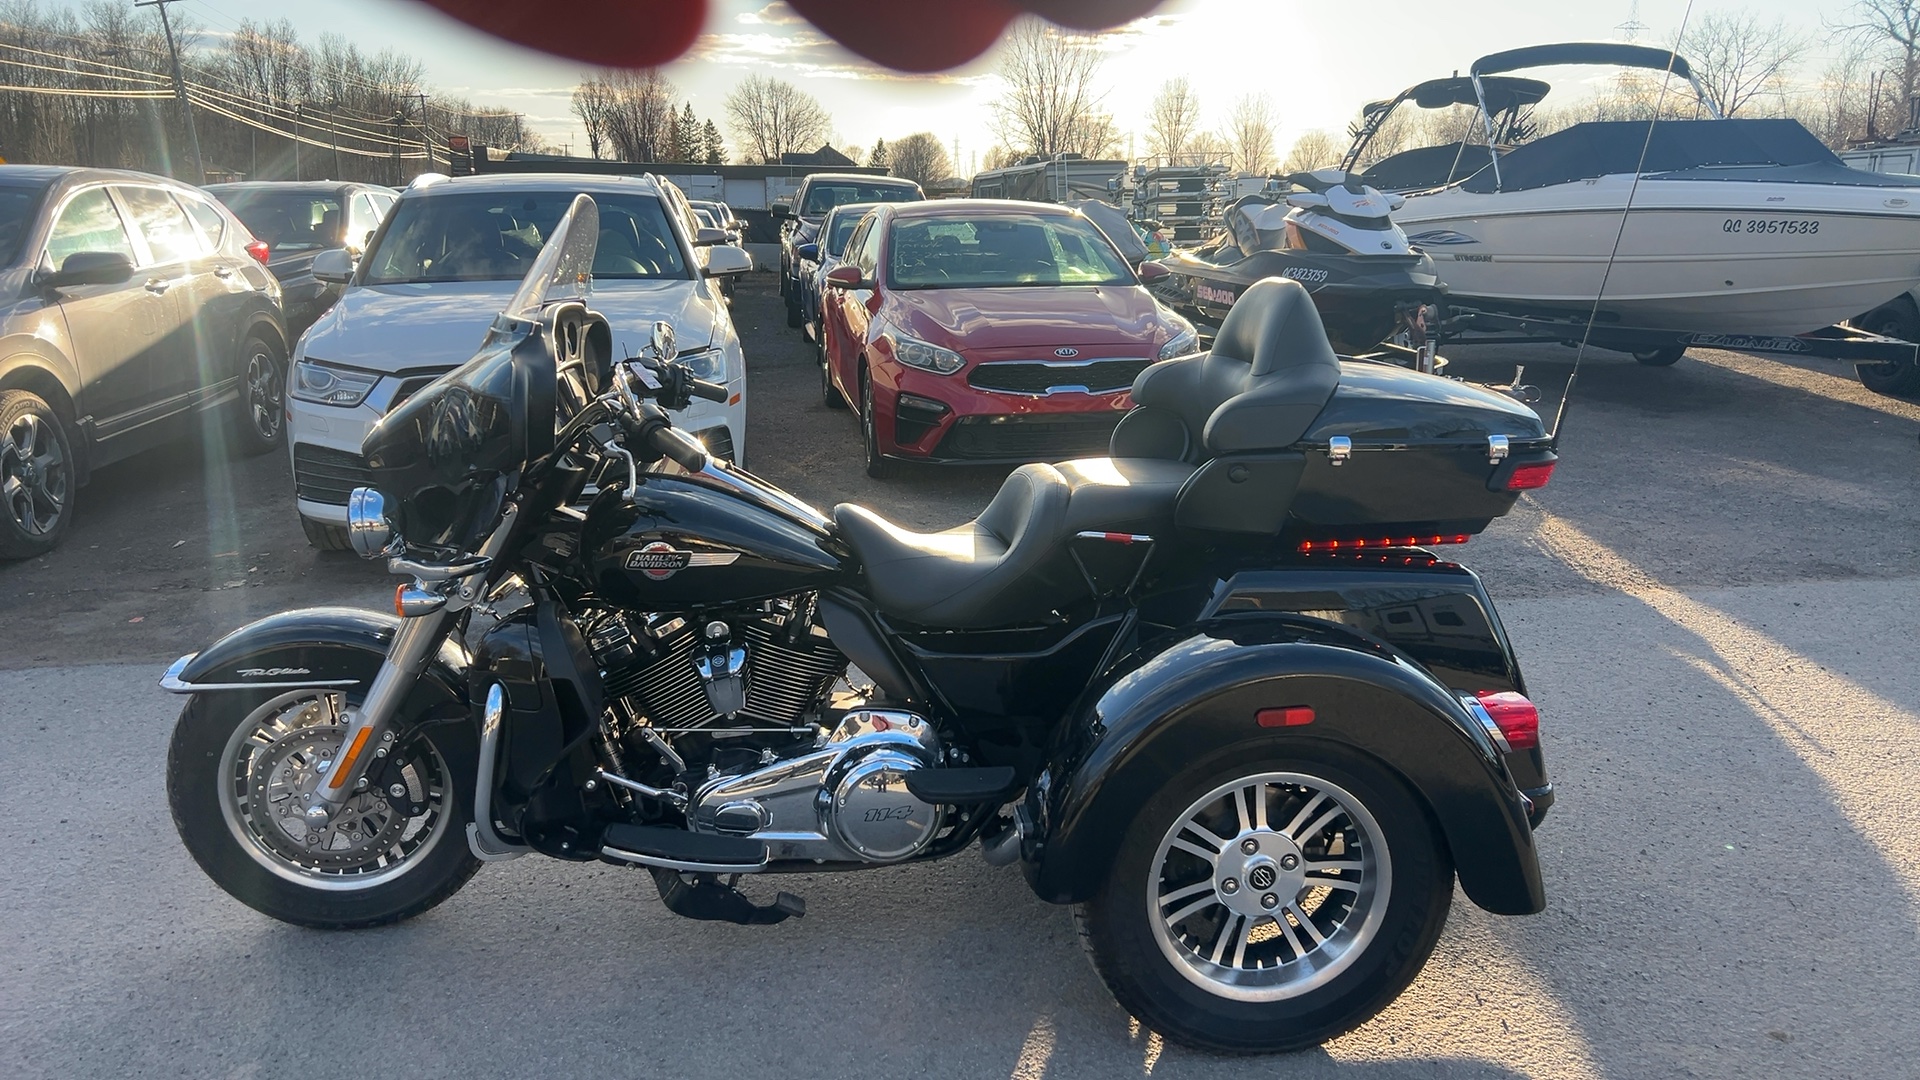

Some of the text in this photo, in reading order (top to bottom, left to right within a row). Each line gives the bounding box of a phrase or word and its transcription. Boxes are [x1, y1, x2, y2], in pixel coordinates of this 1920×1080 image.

[1723, 218, 1742, 233] QC
[629, 560, 684, 568] DAVIDSON
[864, 805, 914, 823] 114
